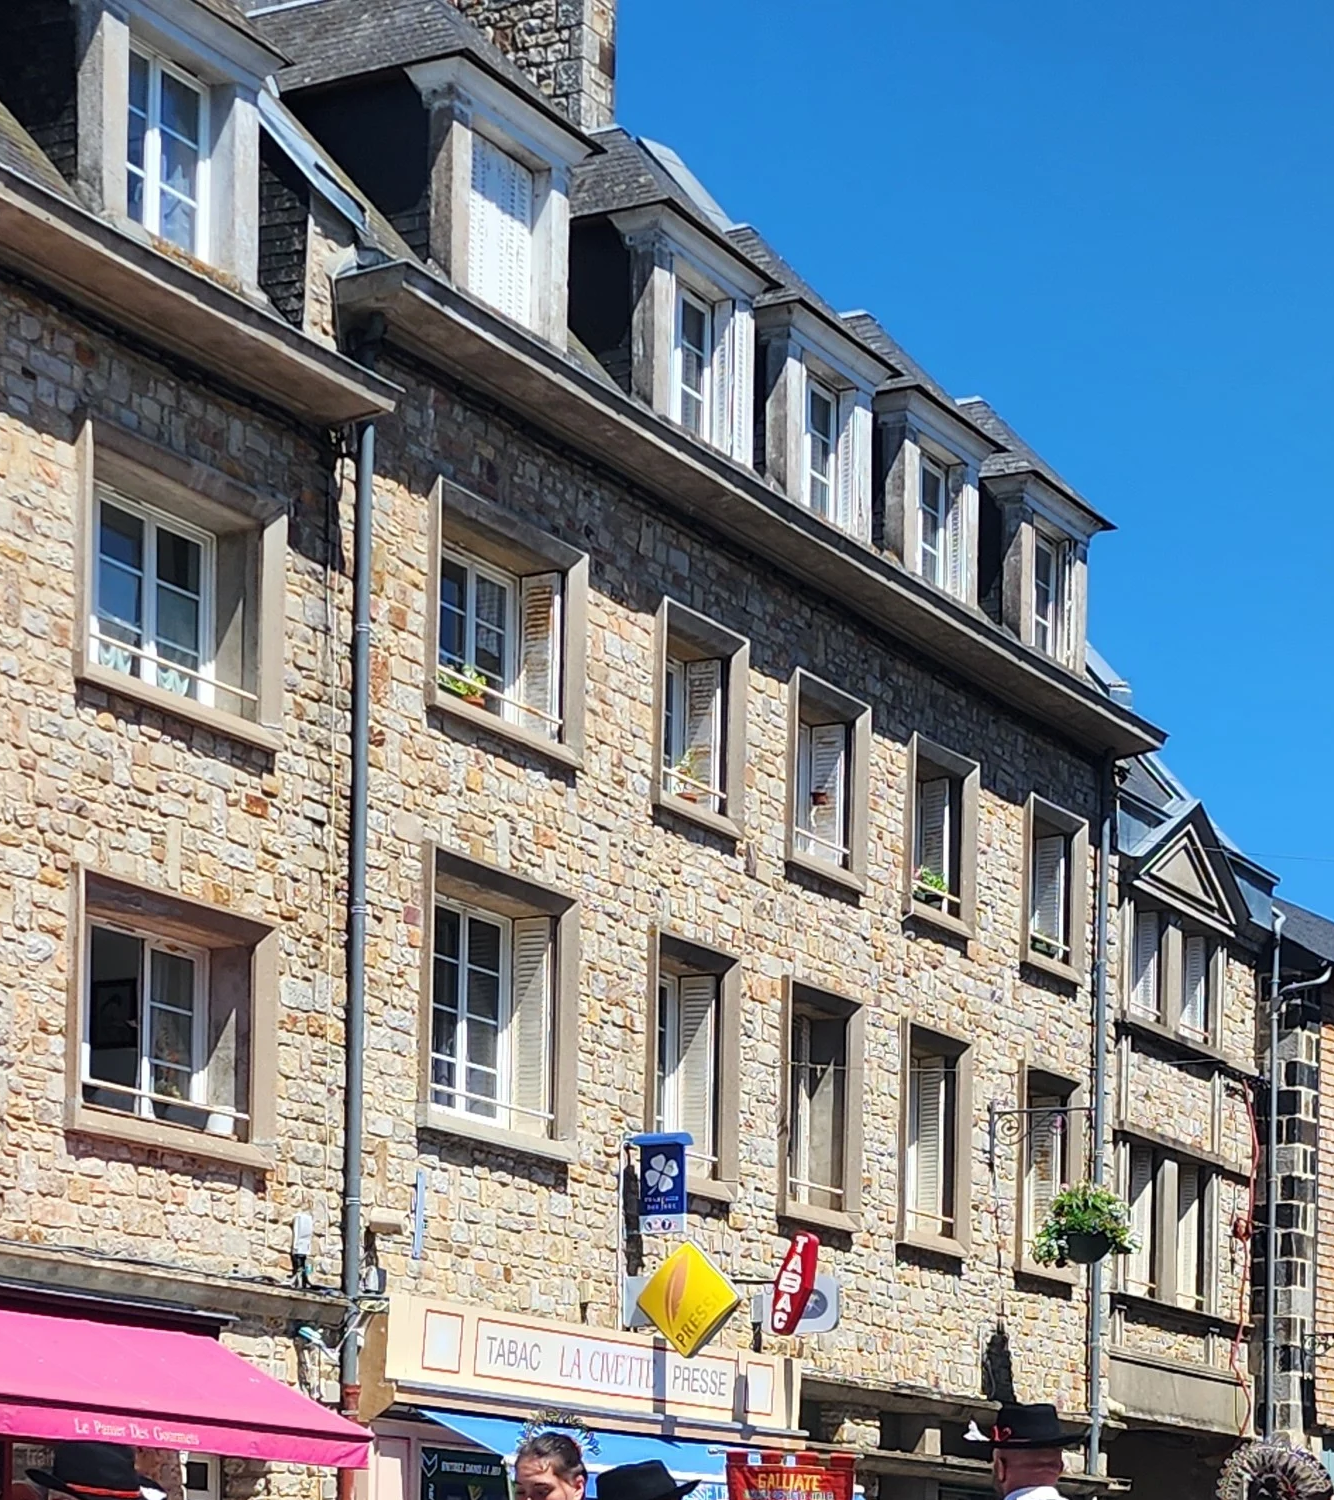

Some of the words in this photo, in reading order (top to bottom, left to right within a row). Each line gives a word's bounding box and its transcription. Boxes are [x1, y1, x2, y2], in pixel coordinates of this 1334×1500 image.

[774, 1235, 808, 1330] TABAC
[485, 1335, 542, 1371] TABAC
[559, 1345, 582, 1380] LA
[672, 1365, 728, 1397] PRESSE
[74, 1417, 90, 1434] Le
[129, 1423, 150, 1439] Des
[26, 1448, 56, 1466] trait
